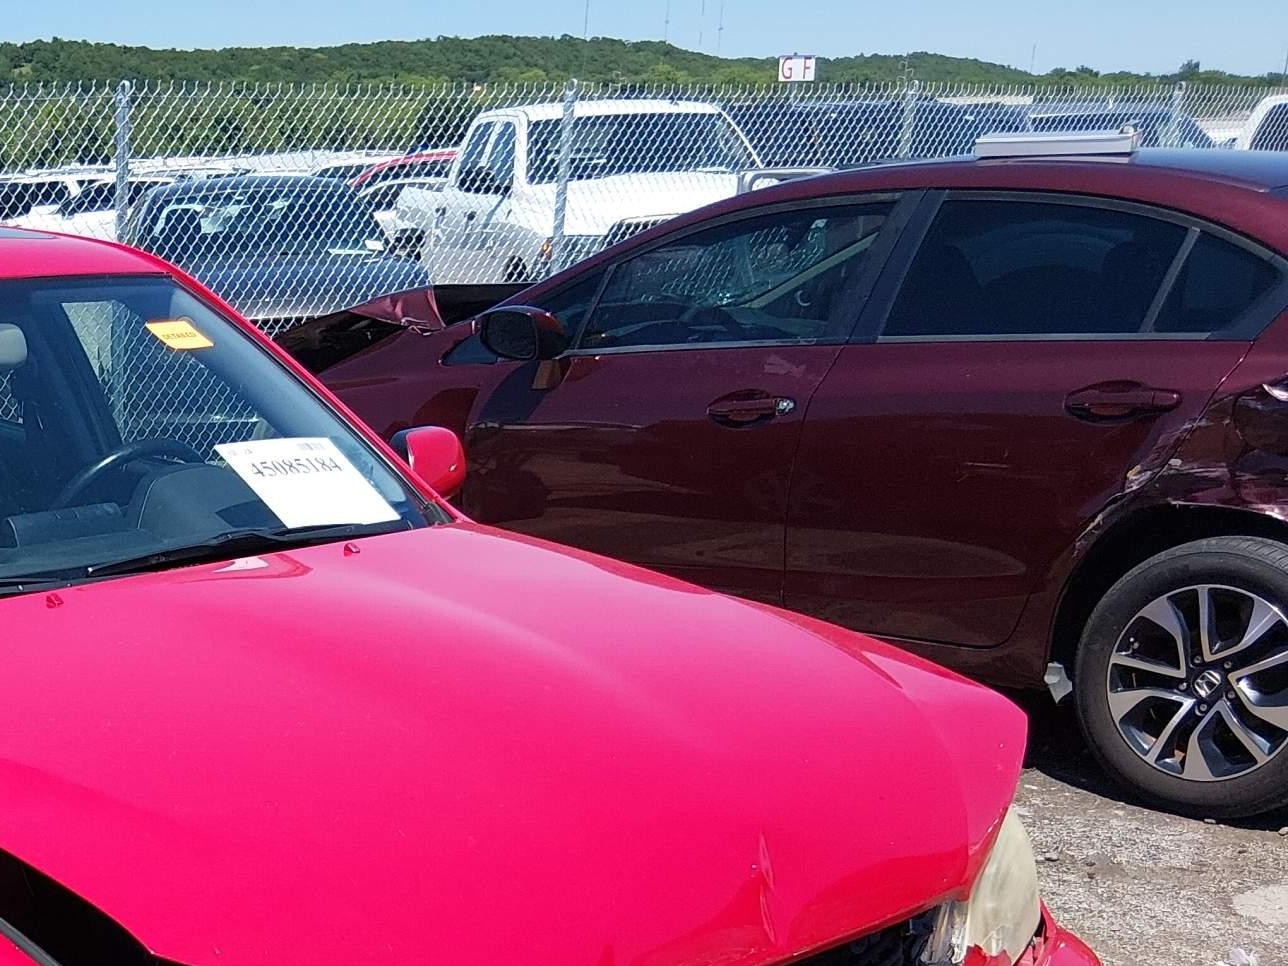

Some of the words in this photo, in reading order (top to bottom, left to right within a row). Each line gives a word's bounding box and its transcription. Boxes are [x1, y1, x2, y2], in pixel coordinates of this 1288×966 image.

[782, 57, 793, 80] G
[803, 56, 813, 80] F
[250, 456, 344, 478] 45085184
